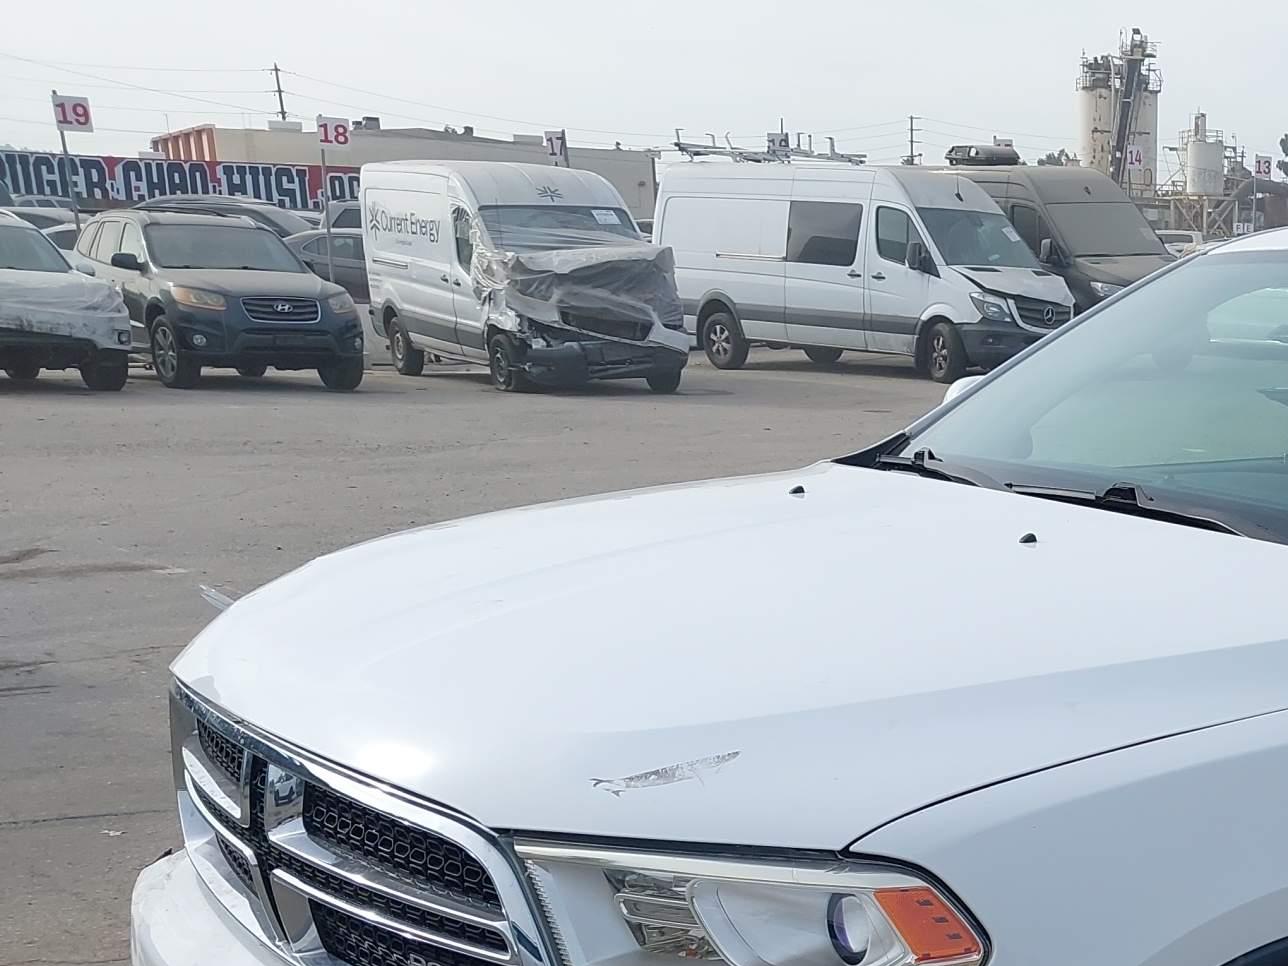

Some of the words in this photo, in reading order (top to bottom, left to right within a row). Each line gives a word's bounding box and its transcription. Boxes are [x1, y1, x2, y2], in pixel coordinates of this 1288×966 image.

[55, 102, 90, 126] 19
[319, 123, 349, 145] 18
[546, 136, 565, 156] 17
[1128, 150, 1142, 166] 14
[1255, 160, 1271, 175] 13
[381, 210, 409, 234] Current
[410, 212, 440, 243] Energy
